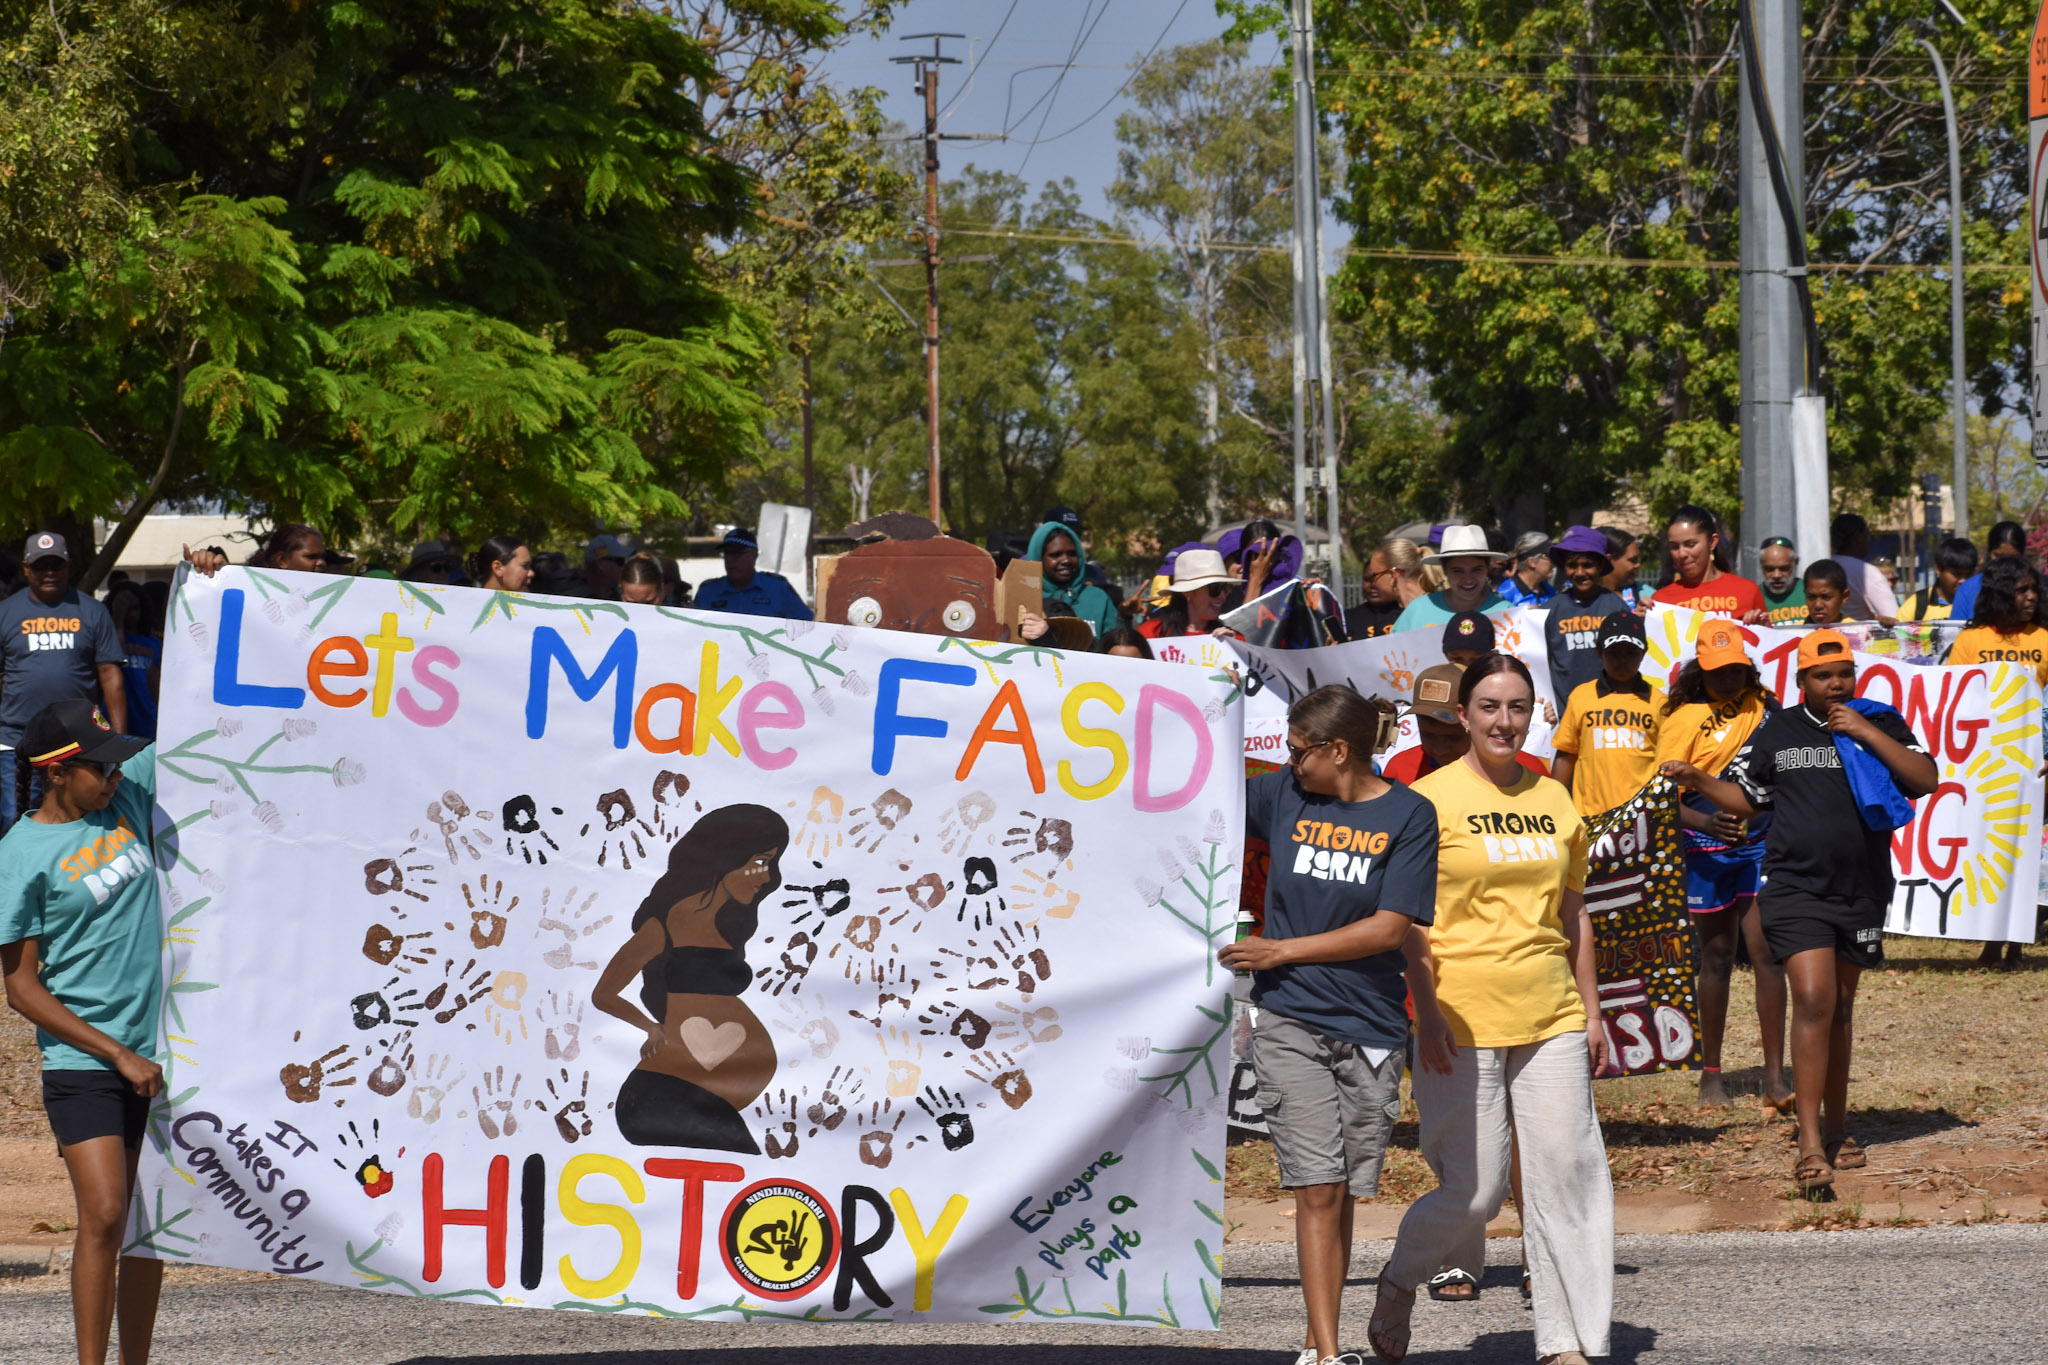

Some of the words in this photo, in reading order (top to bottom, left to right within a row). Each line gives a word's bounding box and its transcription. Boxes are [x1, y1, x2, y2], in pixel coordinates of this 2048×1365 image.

[21, 617, 81, 635] STRONG
[28, 632, 75, 651] BORN
[1565, 631, 1599, 651] BOR
[1978, 649, 2042, 665] STRONG
[213, 588, 461, 727] Lets
[525, 625, 805, 771] Make
[871, 657, 1214, 812] FASD
[1585, 708, 1653, 729] STRONG
[1592, 727, 1647, 750] BORN
[1292, 819, 1389, 855] STRONG
[1467, 812, 1556, 835] STRONG
[60, 815, 137, 882] STRONG
[1292, 845, 1372, 885] BORN
[1482, 835, 1559, 863] BORN
[82, 842, 152, 905] BORN
[227, 1123, 286, 1193] takes
[172, 1111, 325, 1275] Community
[745, 1186, 826, 1220] NINDILINGARRI
[1010, 1151, 1123, 1233] Everyone
[1038, 1218, 1096, 1270] plays
[1107, 1195, 1138, 1215] a
[733, 1256, 760, 1285] CULTURAL
[761, 1280, 790, 1290] HEALTH
[790, 1264, 822, 1288] SERVICES
